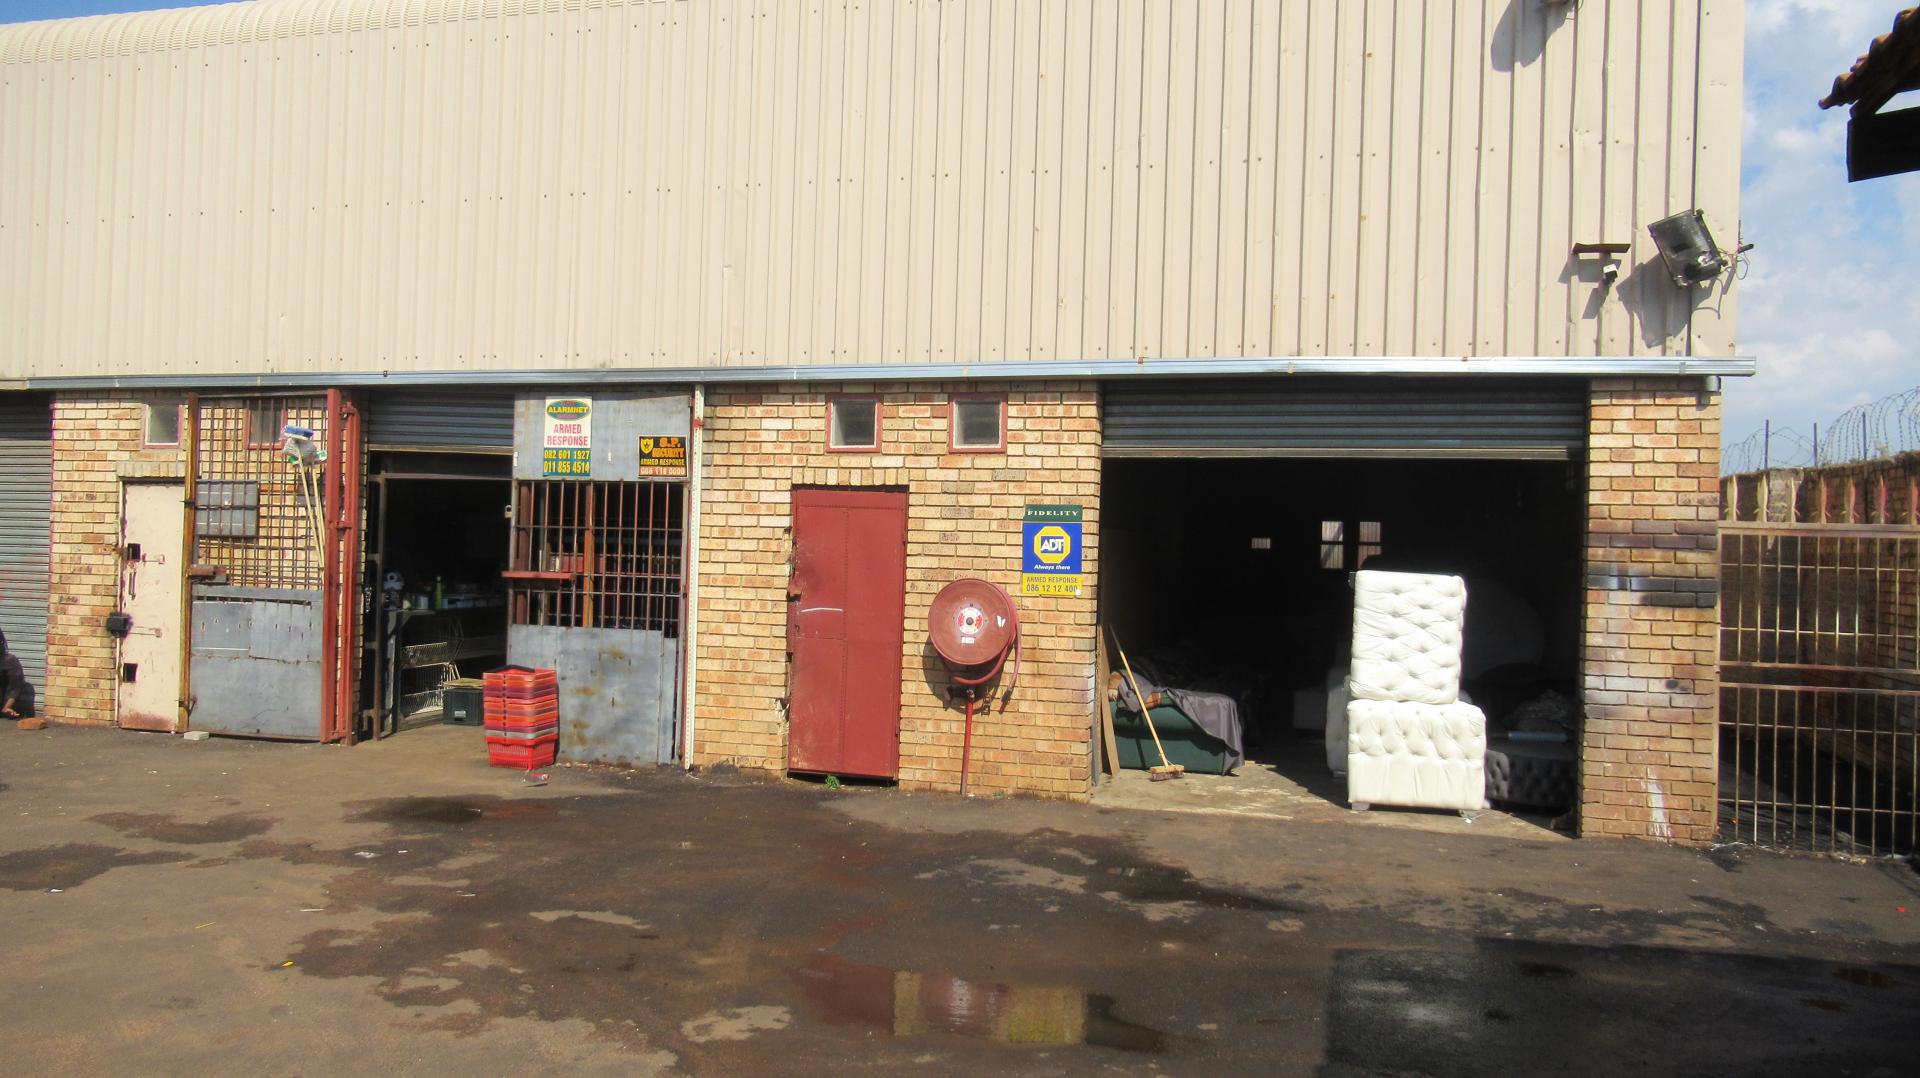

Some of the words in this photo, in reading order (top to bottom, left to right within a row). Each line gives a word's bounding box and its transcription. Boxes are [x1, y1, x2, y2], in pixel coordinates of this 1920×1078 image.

[554, 424, 582, 434] ARMED
[547, 436, 588, 446] RESPONSE
[544, 450, 557, 459] 082
[574, 450, 590, 460] 1927
[652, 447, 684, 458] SECURITY
[544, 461, 556, 473] 011
[1040, 539, 1065, 551] ADT
